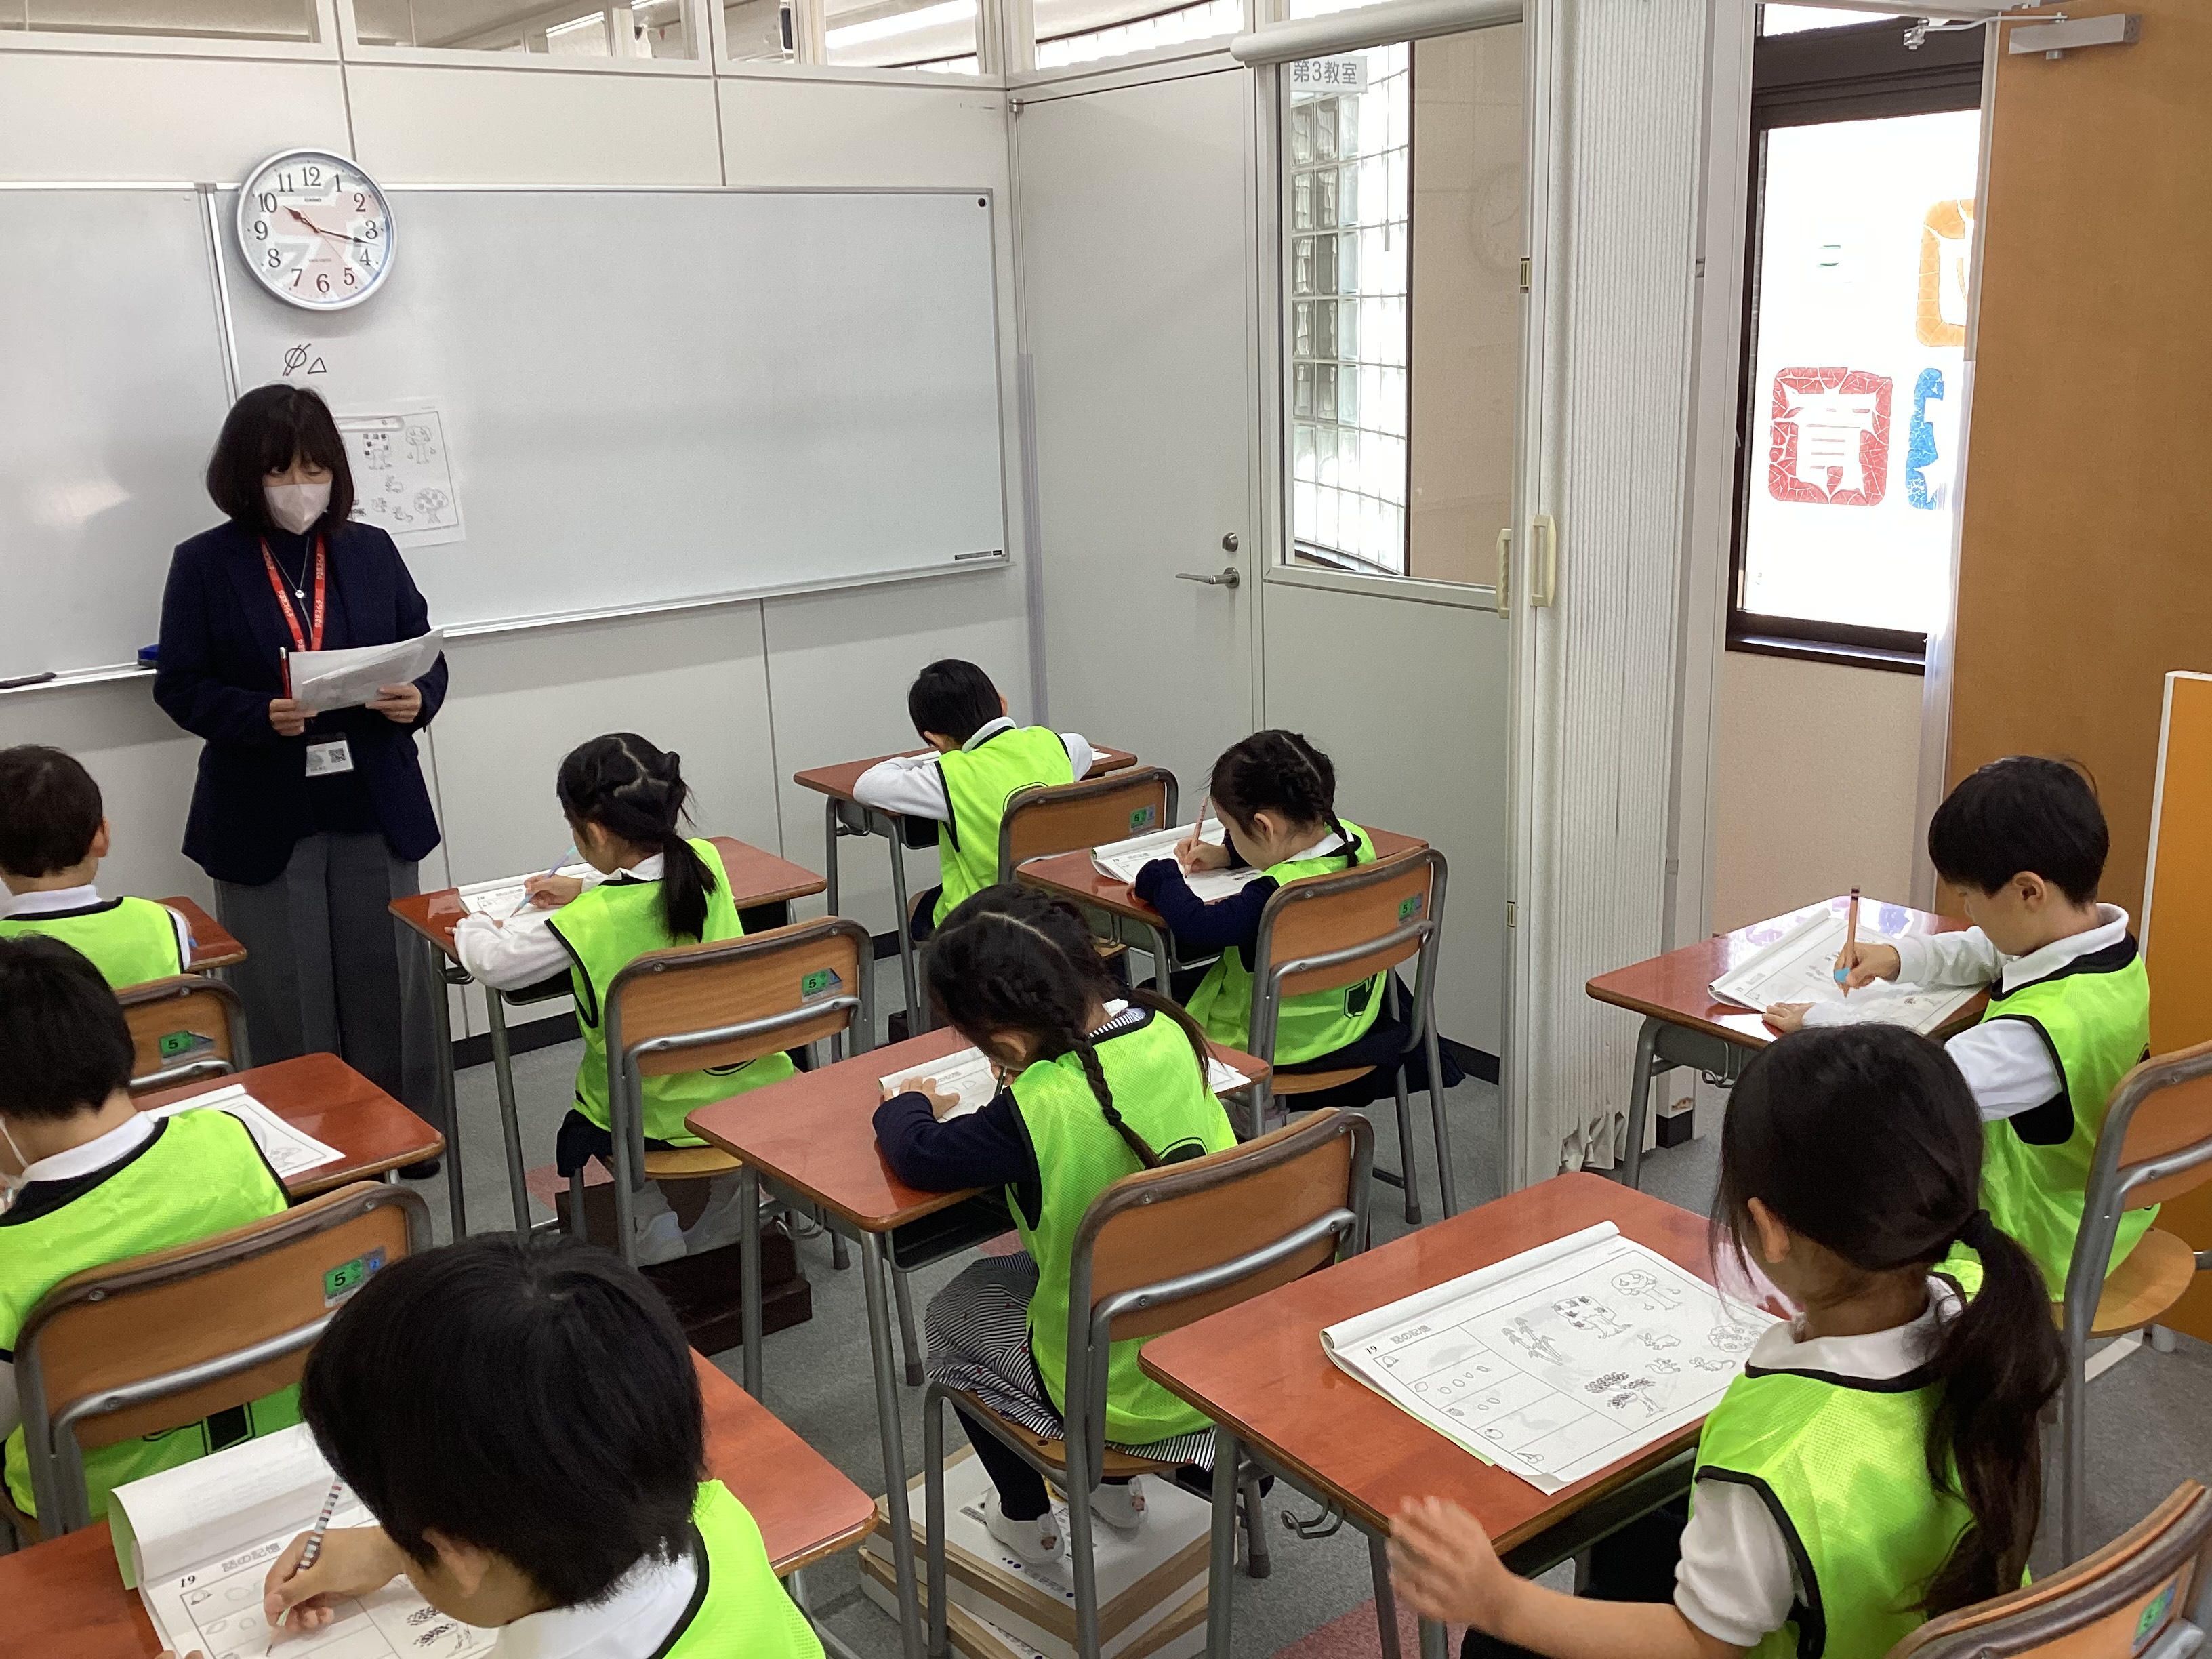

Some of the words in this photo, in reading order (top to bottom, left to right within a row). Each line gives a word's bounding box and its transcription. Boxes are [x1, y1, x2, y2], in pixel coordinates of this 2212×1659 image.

[1293, 59, 1357, 85] 第3教室
[279, 173, 295, 192] 11
[302, 166, 321, 186] 12
[333, 173, 342, 192] 1
[258, 192, 278, 213] 10
[354, 193, 366, 212] 2
[253, 220, 268, 240] 9
[365, 220, 378, 239] 3
[267, 248, 281, 268] 8
[359, 248, 371, 266] 4
[291, 268, 302, 287] 7
[316, 274, 330, 293] 6
[343, 267, 354, 285] 5
[1402, 905, 1408, 913] 5
[808, 978, 817, 988] 5
[168, 1038, 178, 1049] 5
[334, 1271, 346, 1286] 5
[1365, 1345, 1378, 1355] 19
[180, 1574, 196, 1588] 19
